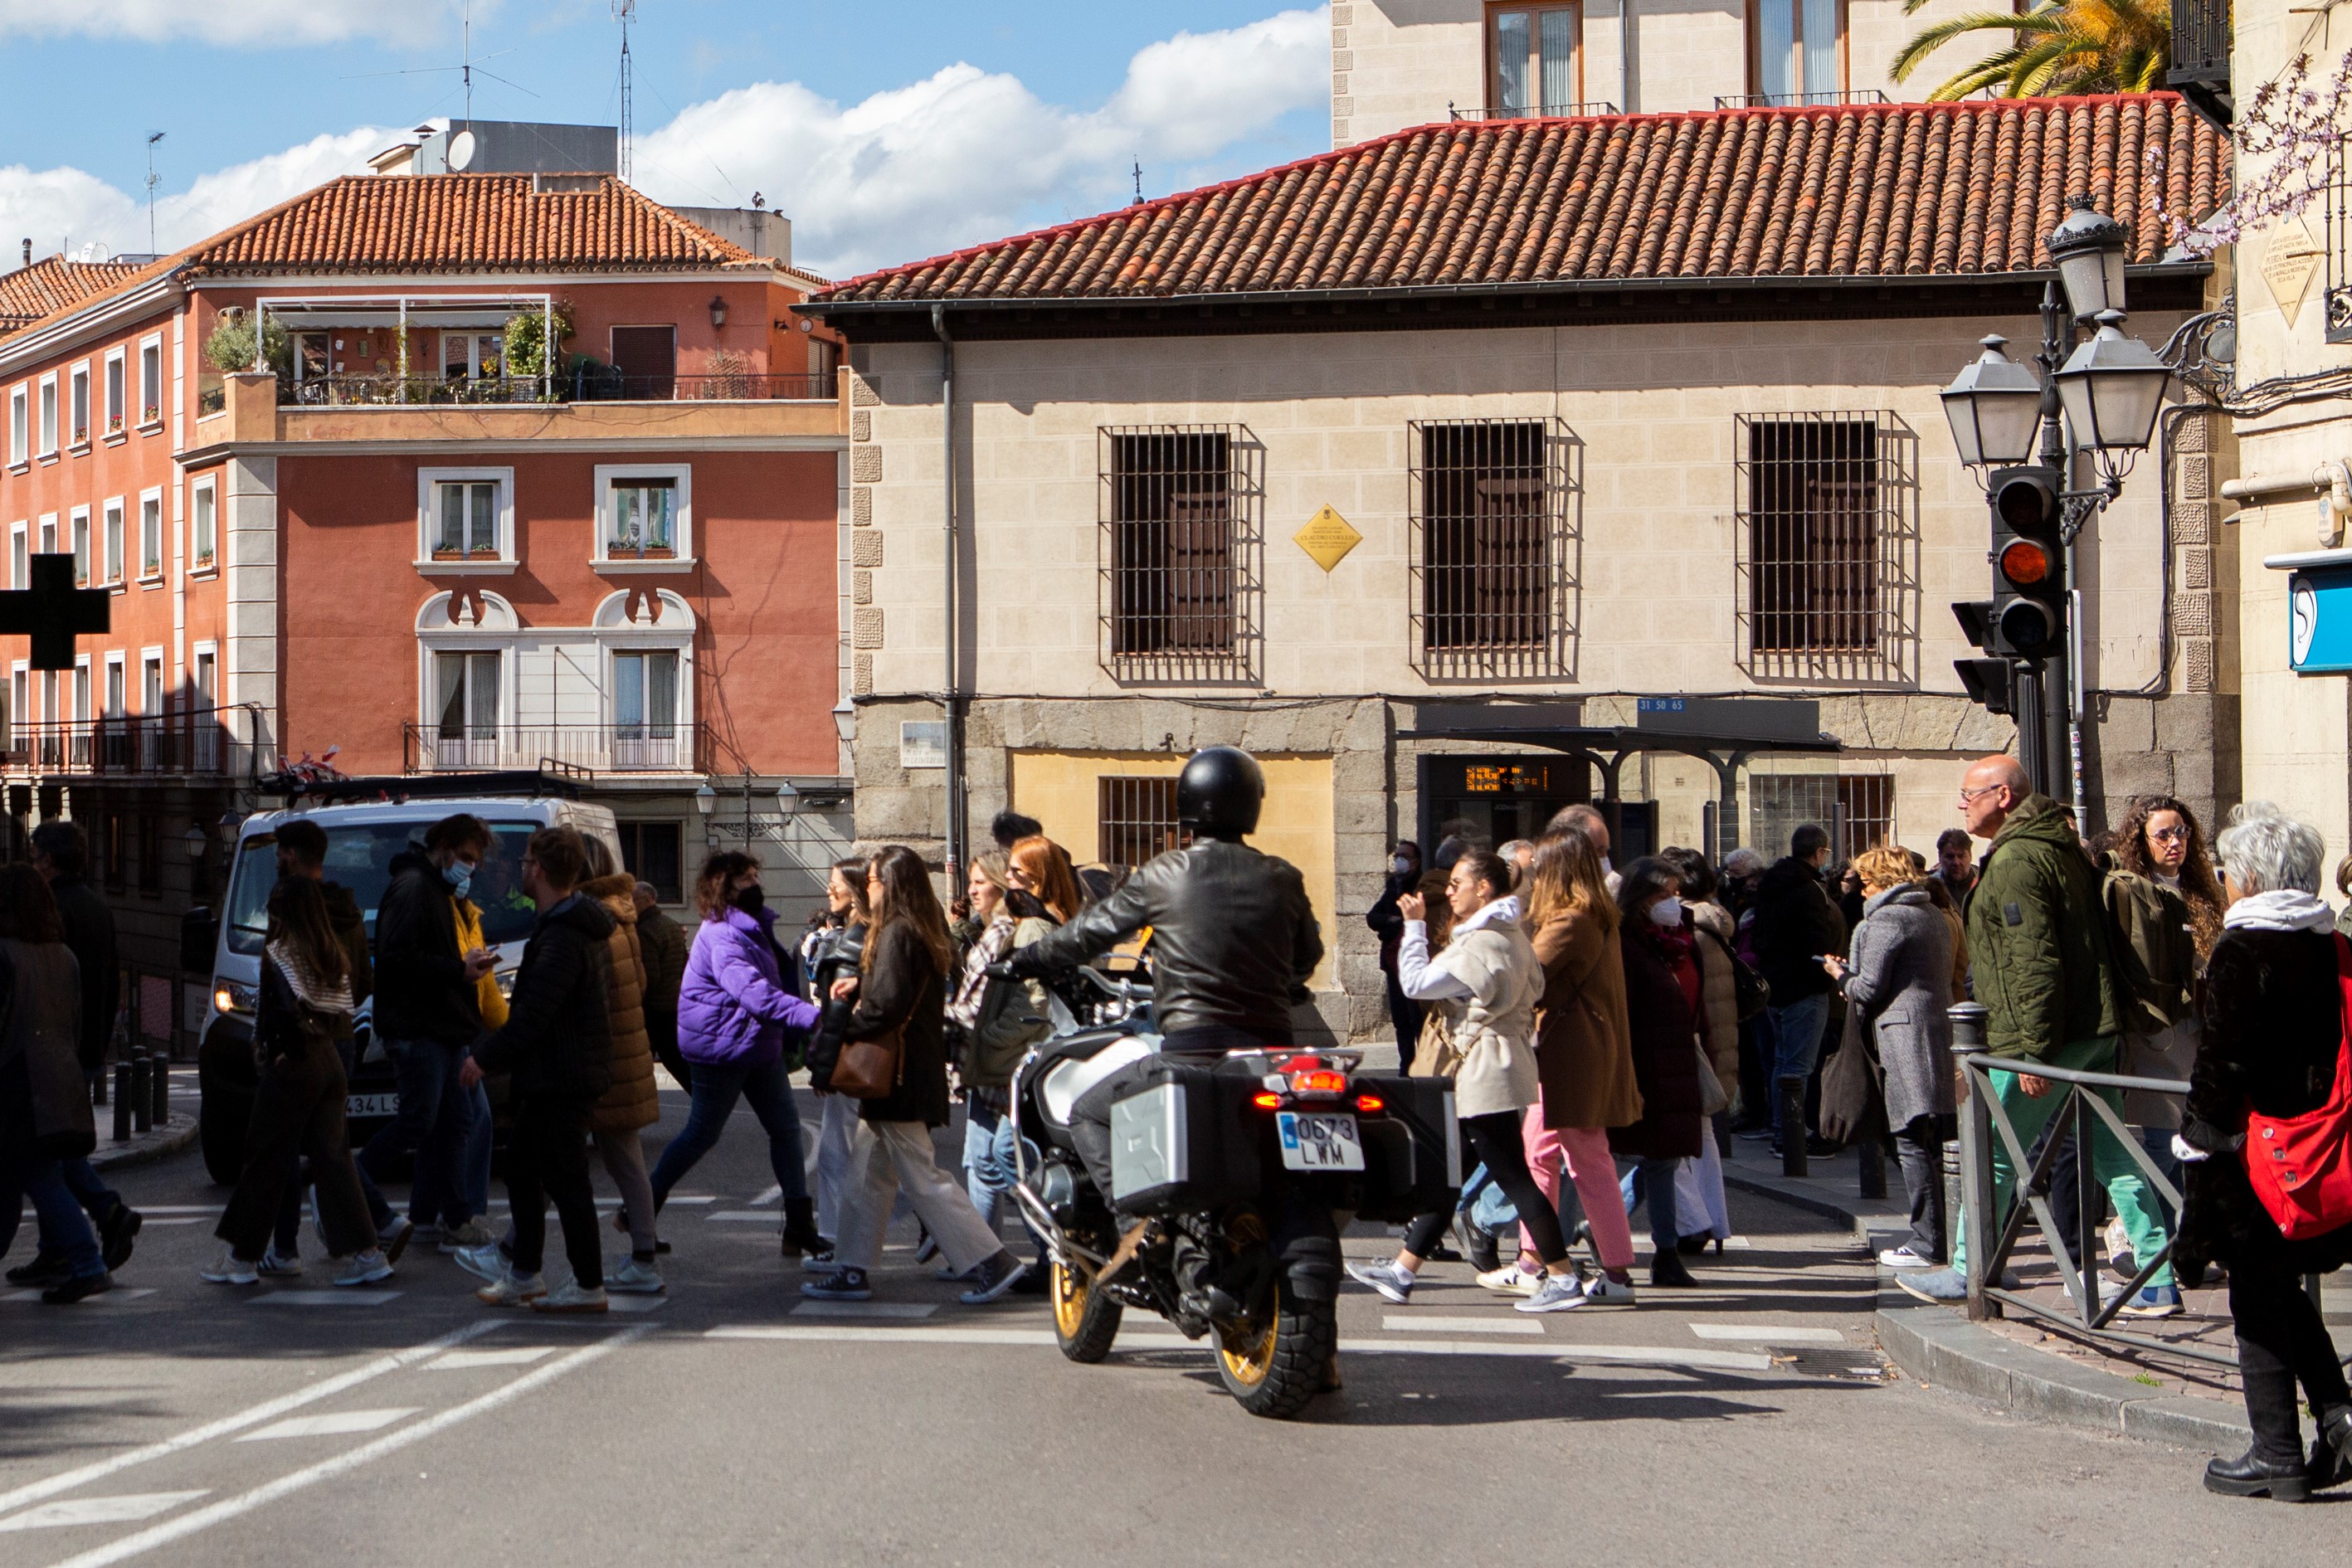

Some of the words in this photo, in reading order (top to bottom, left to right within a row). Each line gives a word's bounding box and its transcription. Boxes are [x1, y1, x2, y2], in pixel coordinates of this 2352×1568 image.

[1640, 700, 1650, 710] 31
[1656, 700, 1667, 710] 50
[1672, 700, 1682, 710] 65
[1298, 1118, 1353, 1140] 0673
[1301, 1142, 1345, 1166] LWM
